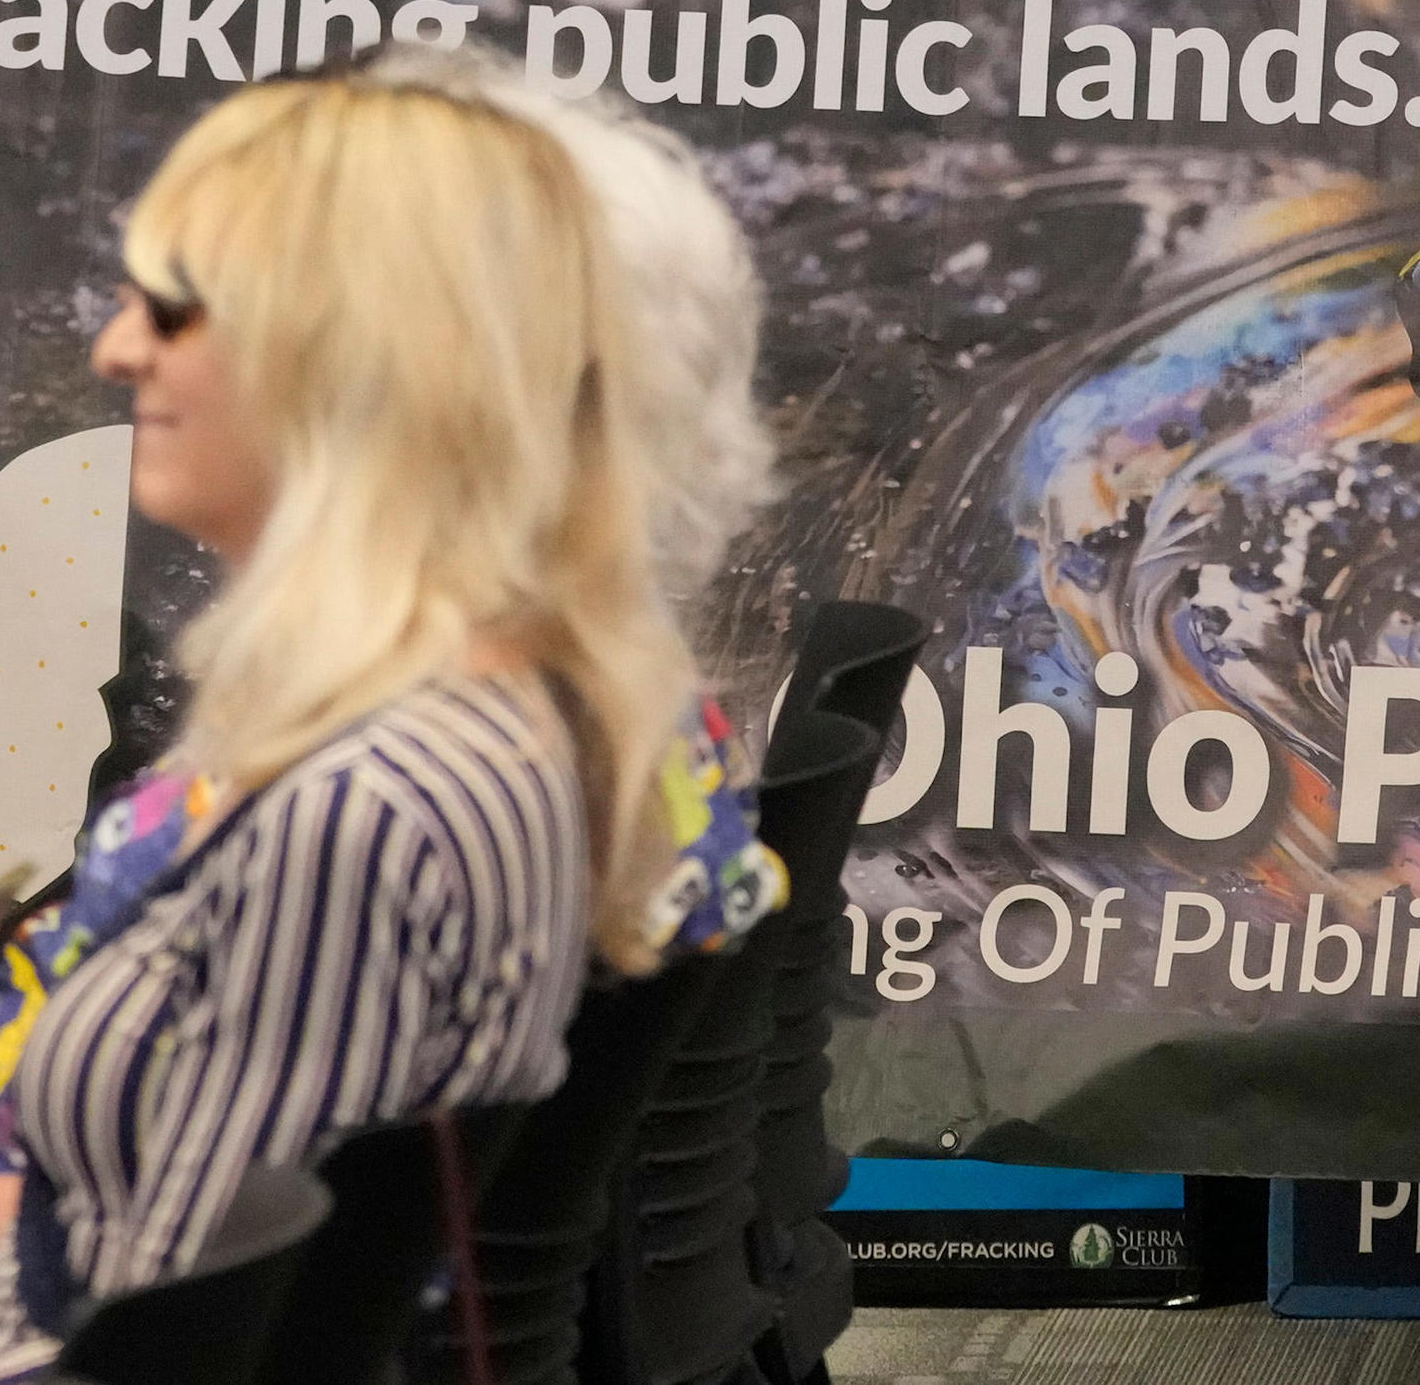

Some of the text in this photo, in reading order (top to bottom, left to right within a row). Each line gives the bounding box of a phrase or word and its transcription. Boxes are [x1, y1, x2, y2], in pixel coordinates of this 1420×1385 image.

[768, 646, 1270, 841] Ohio
[979, 884, 1127, 985] Of
[1116, 1226, 1185, 1247] SIERRA
[846, 1241, 1055, 1261] LUB.ORG/FRACKING
[1121, 1246, 1178, 1266] CLUB
